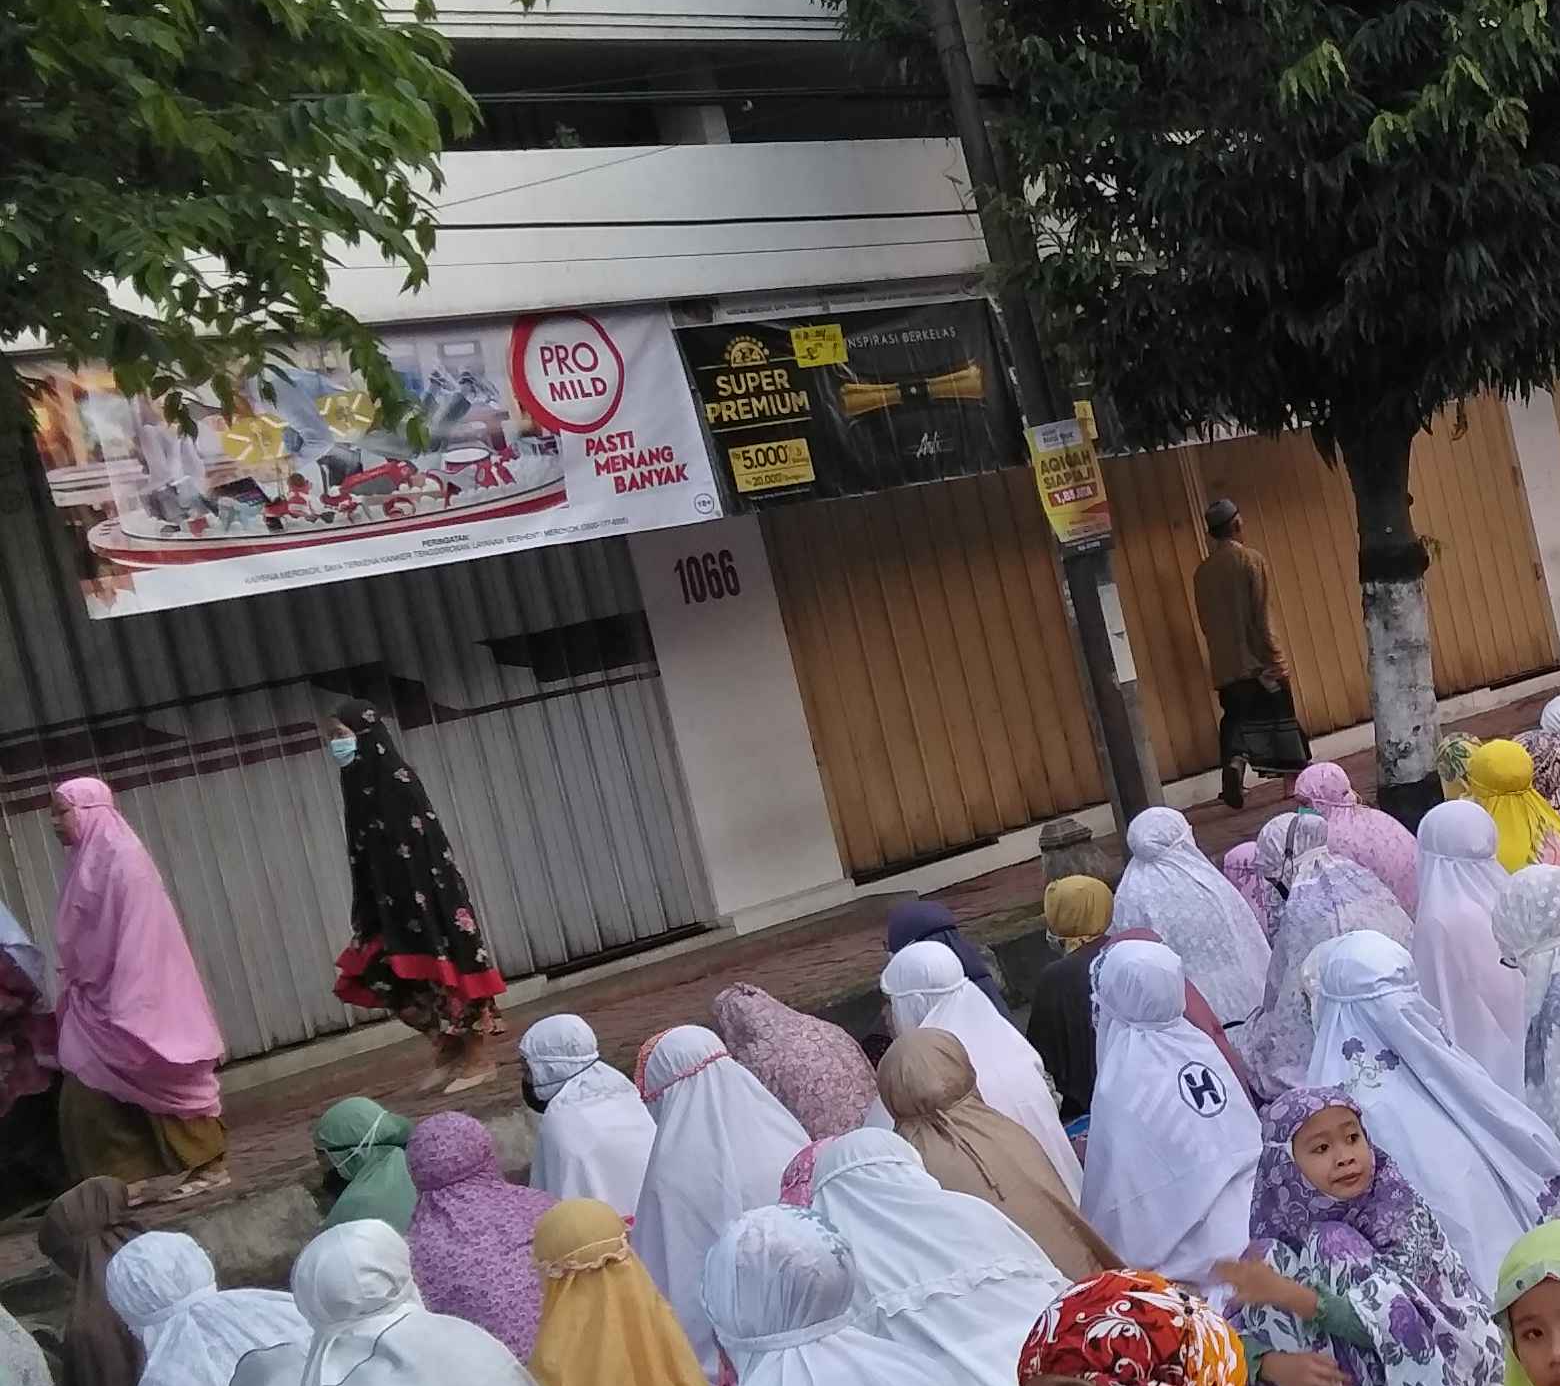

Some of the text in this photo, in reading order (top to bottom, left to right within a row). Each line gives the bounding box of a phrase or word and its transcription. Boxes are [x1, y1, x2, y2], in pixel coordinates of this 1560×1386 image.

[848, 334, 899, 349] NSPIRASI
[902, 326, 957, 343] BERKELAS
[540, 342, 599, 376] PRO
[734, 347, 762, 362] 234
[548, 377, 608, 402] MILD
[716, 369, 791, 397] SUPER
[705, 390, 811, 424] PREMIUM
[585, 431, 636, 457] PASTI
[594, 446, 674, 477] MENANG
[613, 463, 689, 494] BANYAK
[674, 549, 741, 604] 1066
